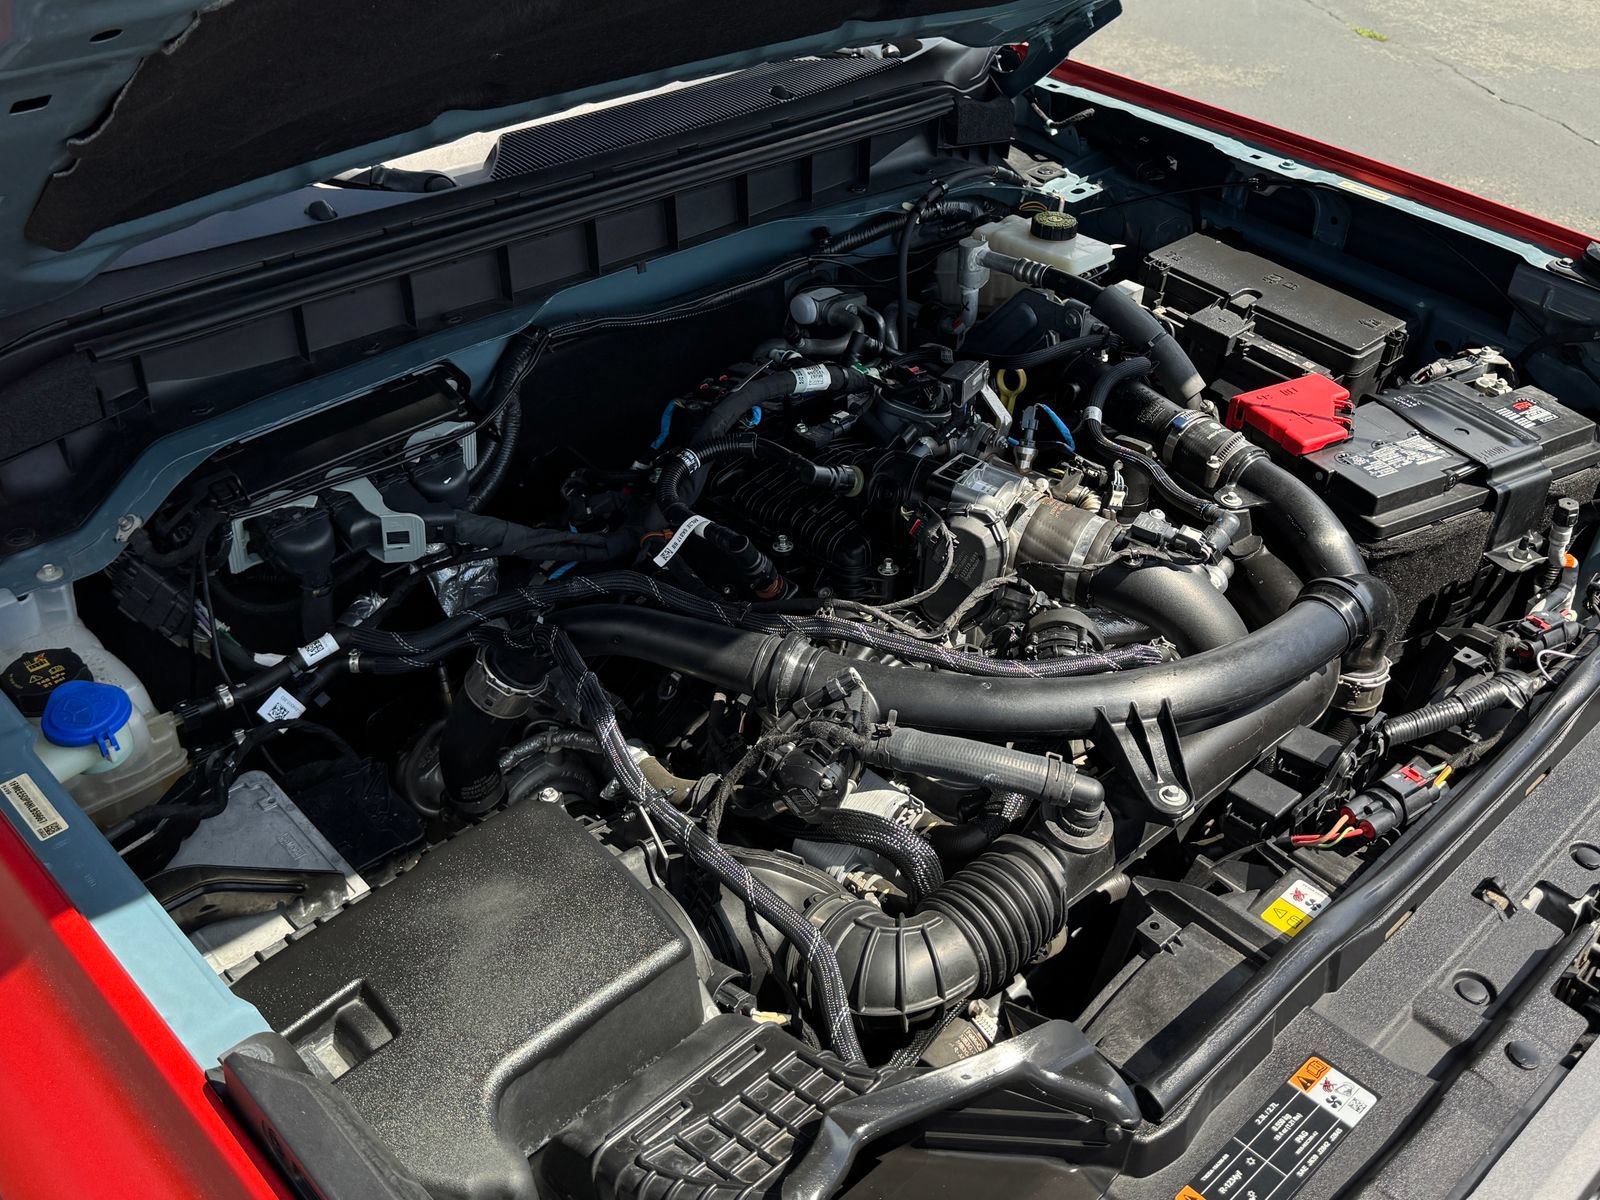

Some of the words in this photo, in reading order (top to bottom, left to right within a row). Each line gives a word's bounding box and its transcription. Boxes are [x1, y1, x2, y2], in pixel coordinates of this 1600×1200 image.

[1254, 1112, 1268, 1125] 2.3L
[1266, 1102, 1280, 1113] 2.7L
[1294, 1130, 1309, 1144] PAG
[1296, 1164, 1309, 1178] SAE
[1217, 1169, 1243, 1195] R-1234yf
